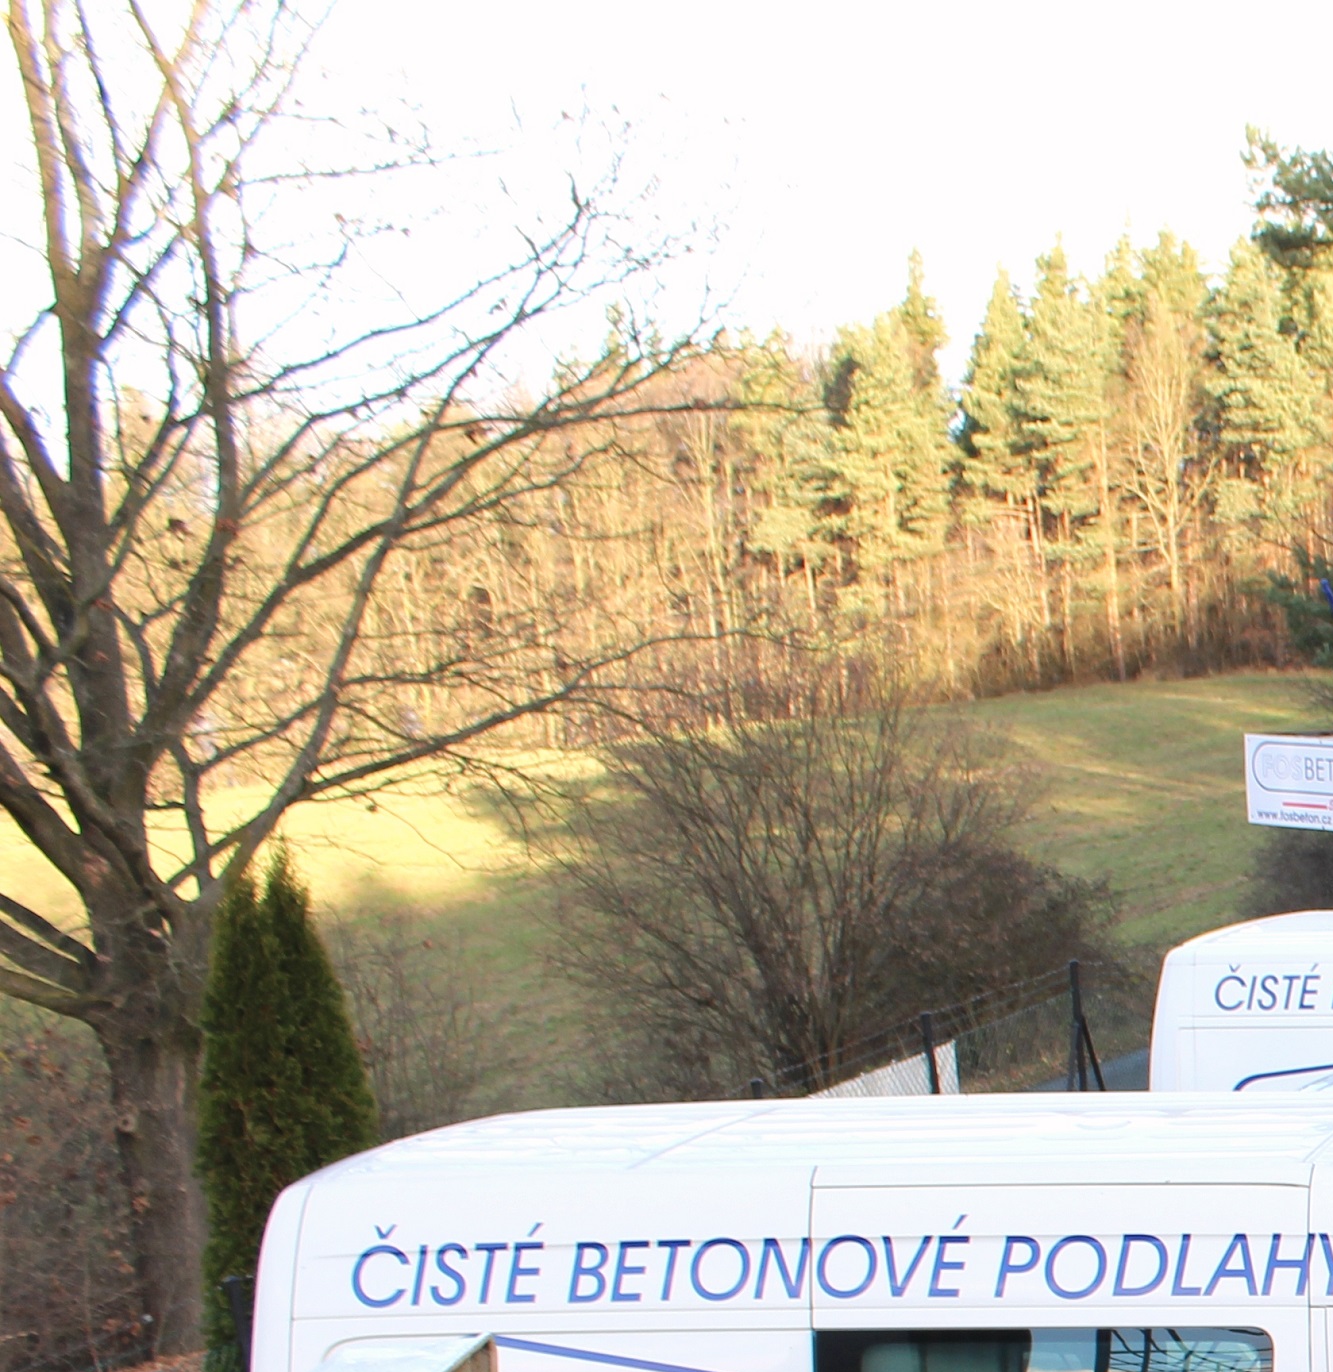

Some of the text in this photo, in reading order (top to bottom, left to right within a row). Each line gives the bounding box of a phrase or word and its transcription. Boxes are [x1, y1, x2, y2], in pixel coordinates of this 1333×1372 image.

[1214, 963, 1319, 1011] ČISTÉ
[352, 1221, 544, 1308] ČISTÉ
[567, 1213, 970, 1304] BETONOVÉ
